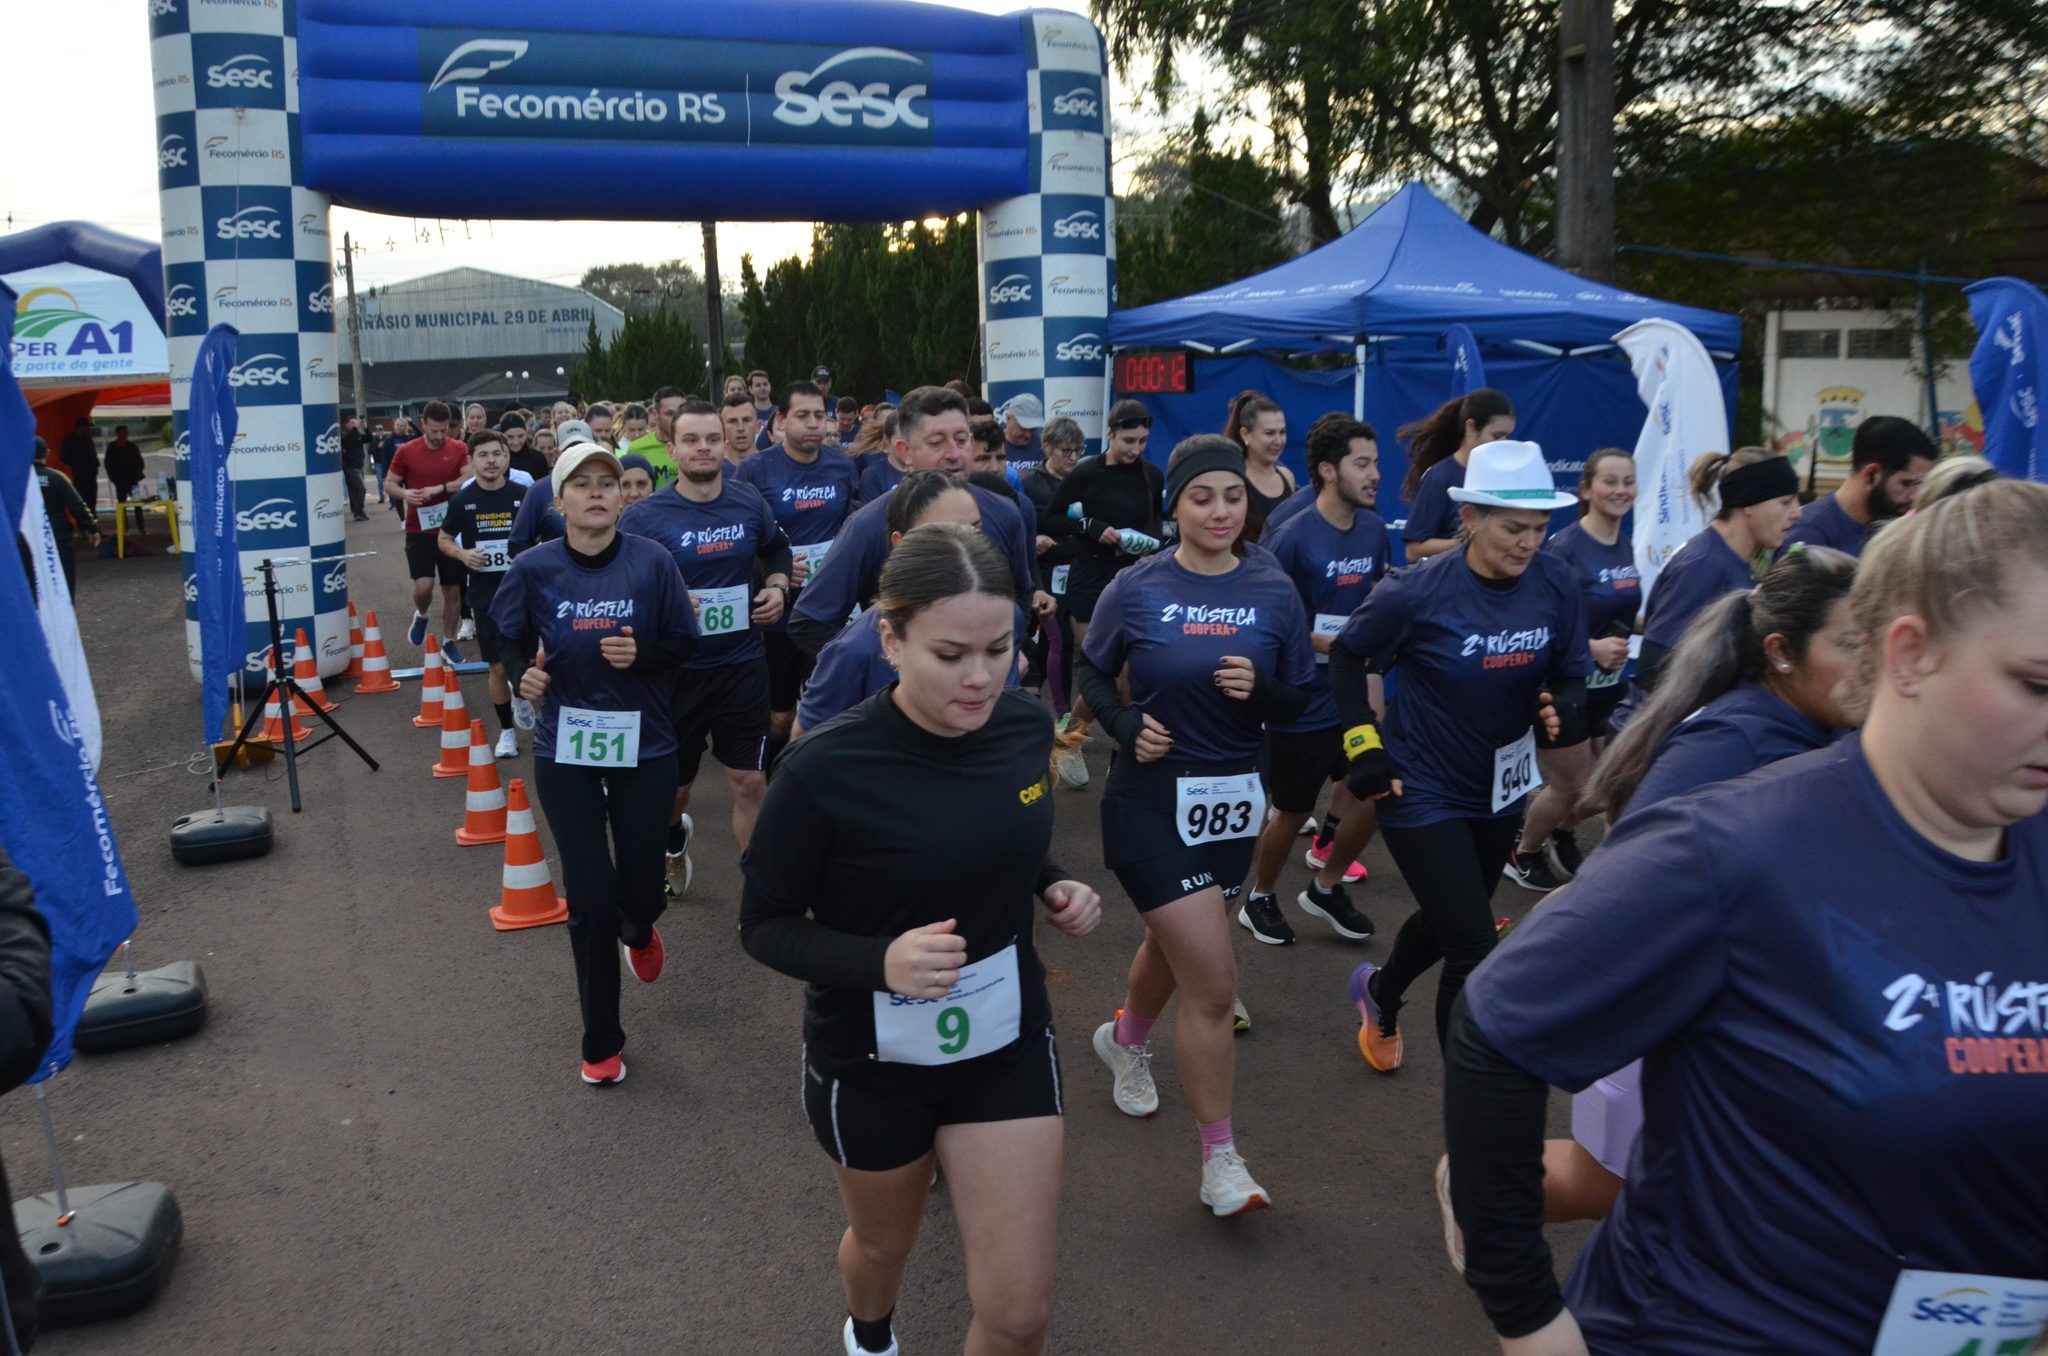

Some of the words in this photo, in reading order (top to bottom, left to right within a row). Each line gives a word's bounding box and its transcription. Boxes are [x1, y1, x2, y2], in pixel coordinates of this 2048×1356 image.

[207, 64, 273, 89] Sesc
[456, 87, 667, 122] Fecomércio
[678, 92, 726, 124] RS
[773, 70, 928, 129] Sesc
[159, 147, 187, 169] esc
[209, 149, 269, 159] Fecomércio
[271, 150, 285, 160] RS
[187, 226, 199, 235] RS
[216, 217, 281, 239] Sesc
[1053, 218, 1100, 240] Sesc
[219, 300, 277, 308] Fecomércio
[280, 298, 293, 307] RS
[308, 291, 333, 313] Ses
[989, 284, 1031, 304] Sesc
[415, 311, 499, 328] MUNICIPAL
[504, 310, 524, 325] 29
[528, 309, 547, 324] DE
[552, 307, 592, 323] ABRIL
[66, 320, 133, 355] A1
[1055, 341, 1102, 362] Sesc
[92, 358, 133, 371] gente
[228, 365, 289, 387] Sesc
[232, 445, 286, 455] ecomércio
[288, 443, 300, 451] RS
[215, 466, 225, 538] Sindicatos
[236, 510, 297, 531] Sesc
[476, 512, 512, 520] FINISHER
[697, 523, 745, 544] RÚSTICA
[482, 552, 512, 567] 38
[296, 585, 309, 593] RS
[576, 599, 634, 619] RÚSTICA
[704, 605, 734, 631] 68
[1186, 604, 1256, 626] RÚSTICA
[573, 618, 618, 631] COOPERA+
[1183, 623, 1239, 636] COOPERA+
[1483, 653, 1536, 669] COOPERA+
[567, 716, 593, 728] Sesc
[569, 729, 625, 762] 151
[1501, 752, 1531, 802] 940
[1186, 787, 1209, 796] Sesc
[77, 747, 123, 896] Fecomércio
[1187, 800, 1252, 839] 983
[1181, 872, 1213, 891] RUN
[1881, 973, 1940, 1032] 2ª
[1945, 971, 2048, 1037] RÚST
[936, 1006, 970, 1055] 9
[1909, 1297, 1990, 1326] Sesc
